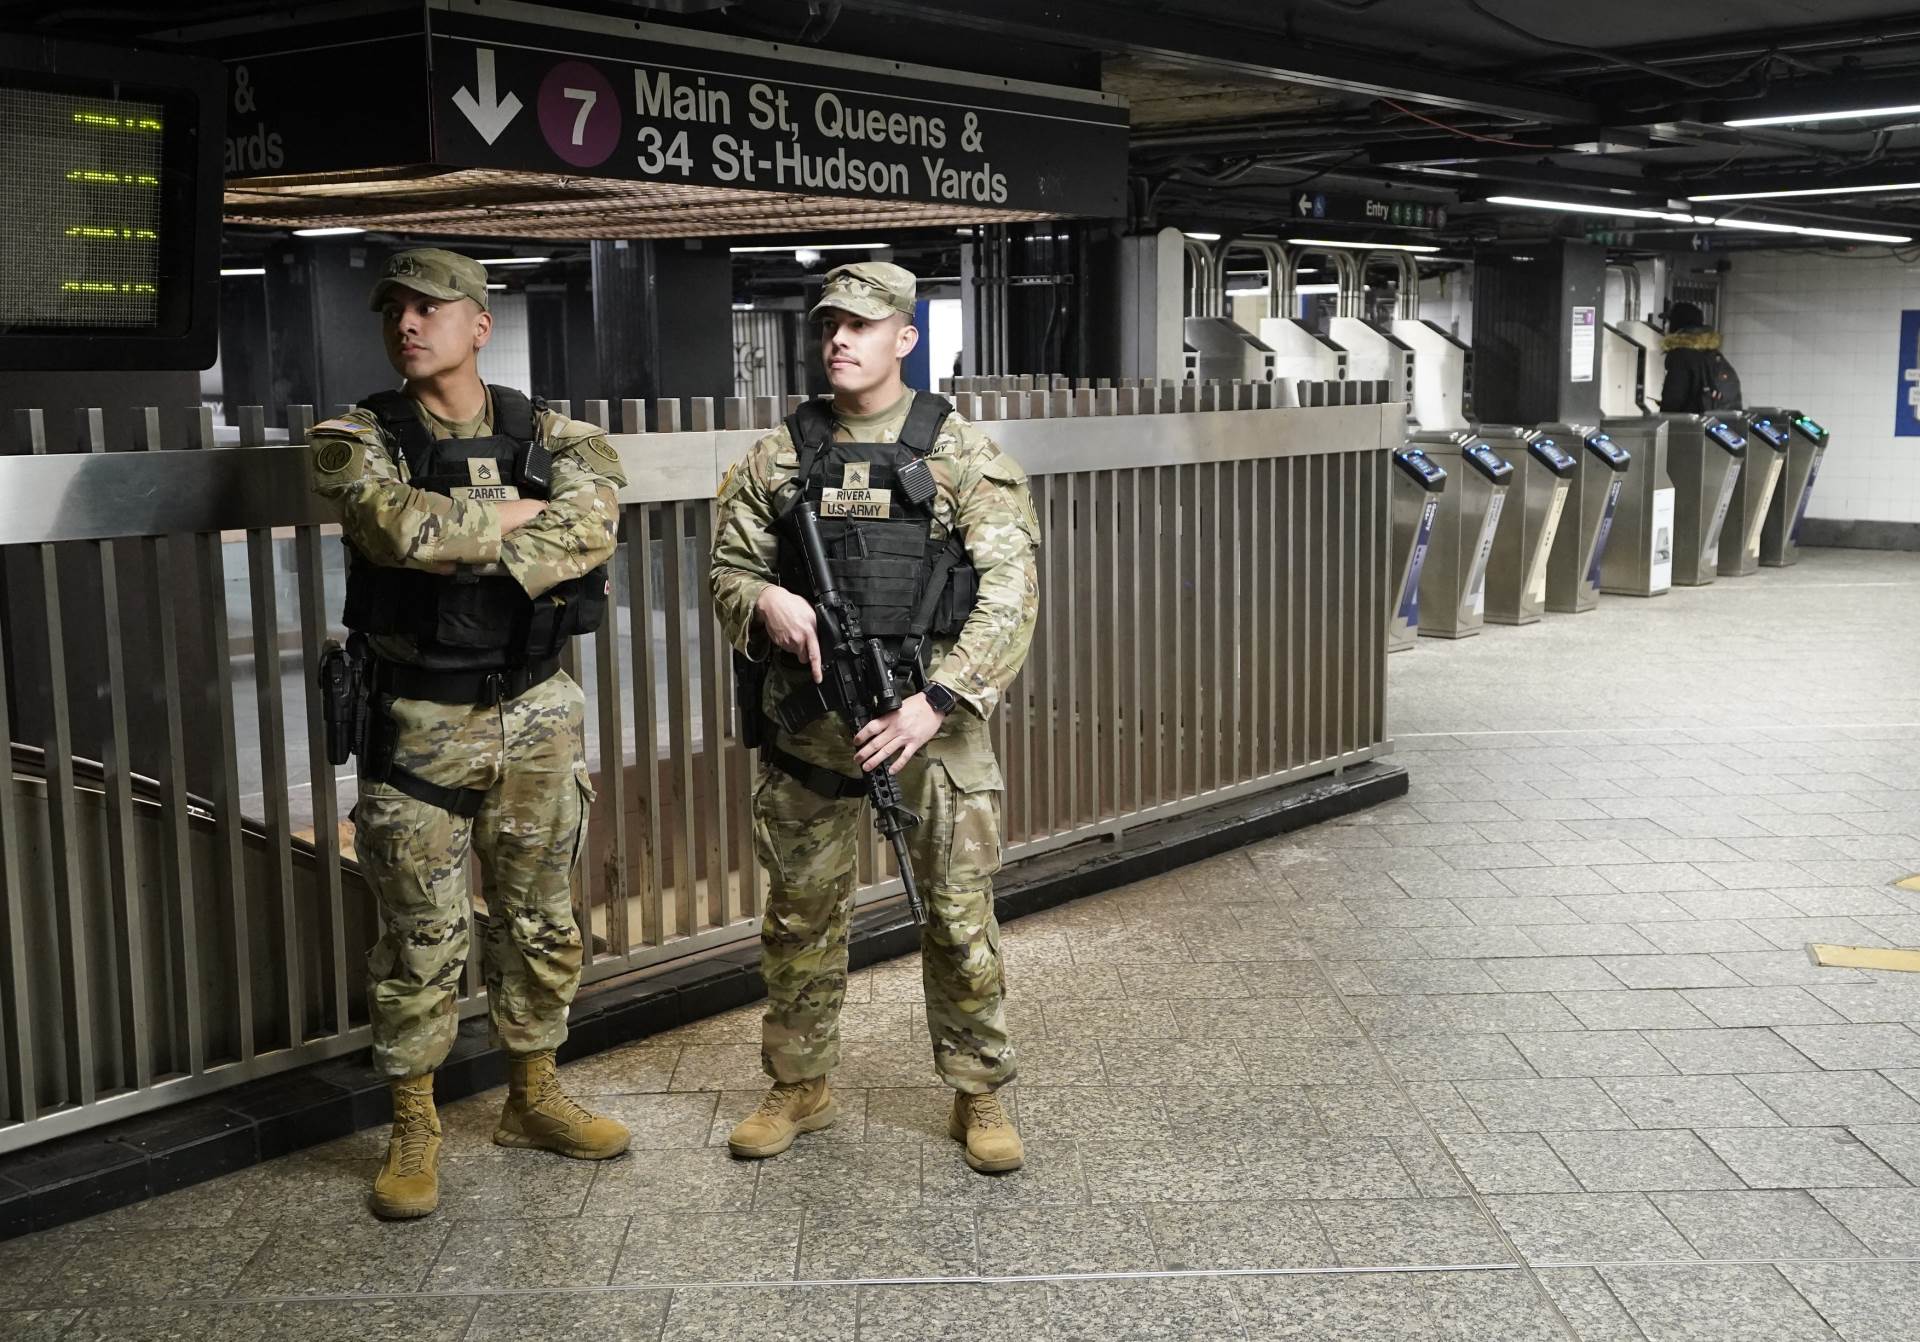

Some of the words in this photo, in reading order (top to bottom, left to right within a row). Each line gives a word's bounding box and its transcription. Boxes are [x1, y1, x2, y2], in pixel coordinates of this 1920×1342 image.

[235, 64, 257, 114] &
[634, 68, 731, 125] Main
[748, 82, 799, 141] St,
[814, 92, 947, 149] Queens
[960, 111, 984, 153] &
[563, 87, 597, 146] 7
[224, 122, 285, 174] ards
[637, 126, 694, 177] 34
[711, 133, 910, 196] St-Hudson
[922, 156, 1009, 204] Yards
[1366, 200, 1390, 221] Entry
[467, 487, 507, 500] ZARATE
[827, 504, 847, 515] U.S.
[850, 504, 882, 516] ARMY
[836, 490, 872, 501] RIVERA
